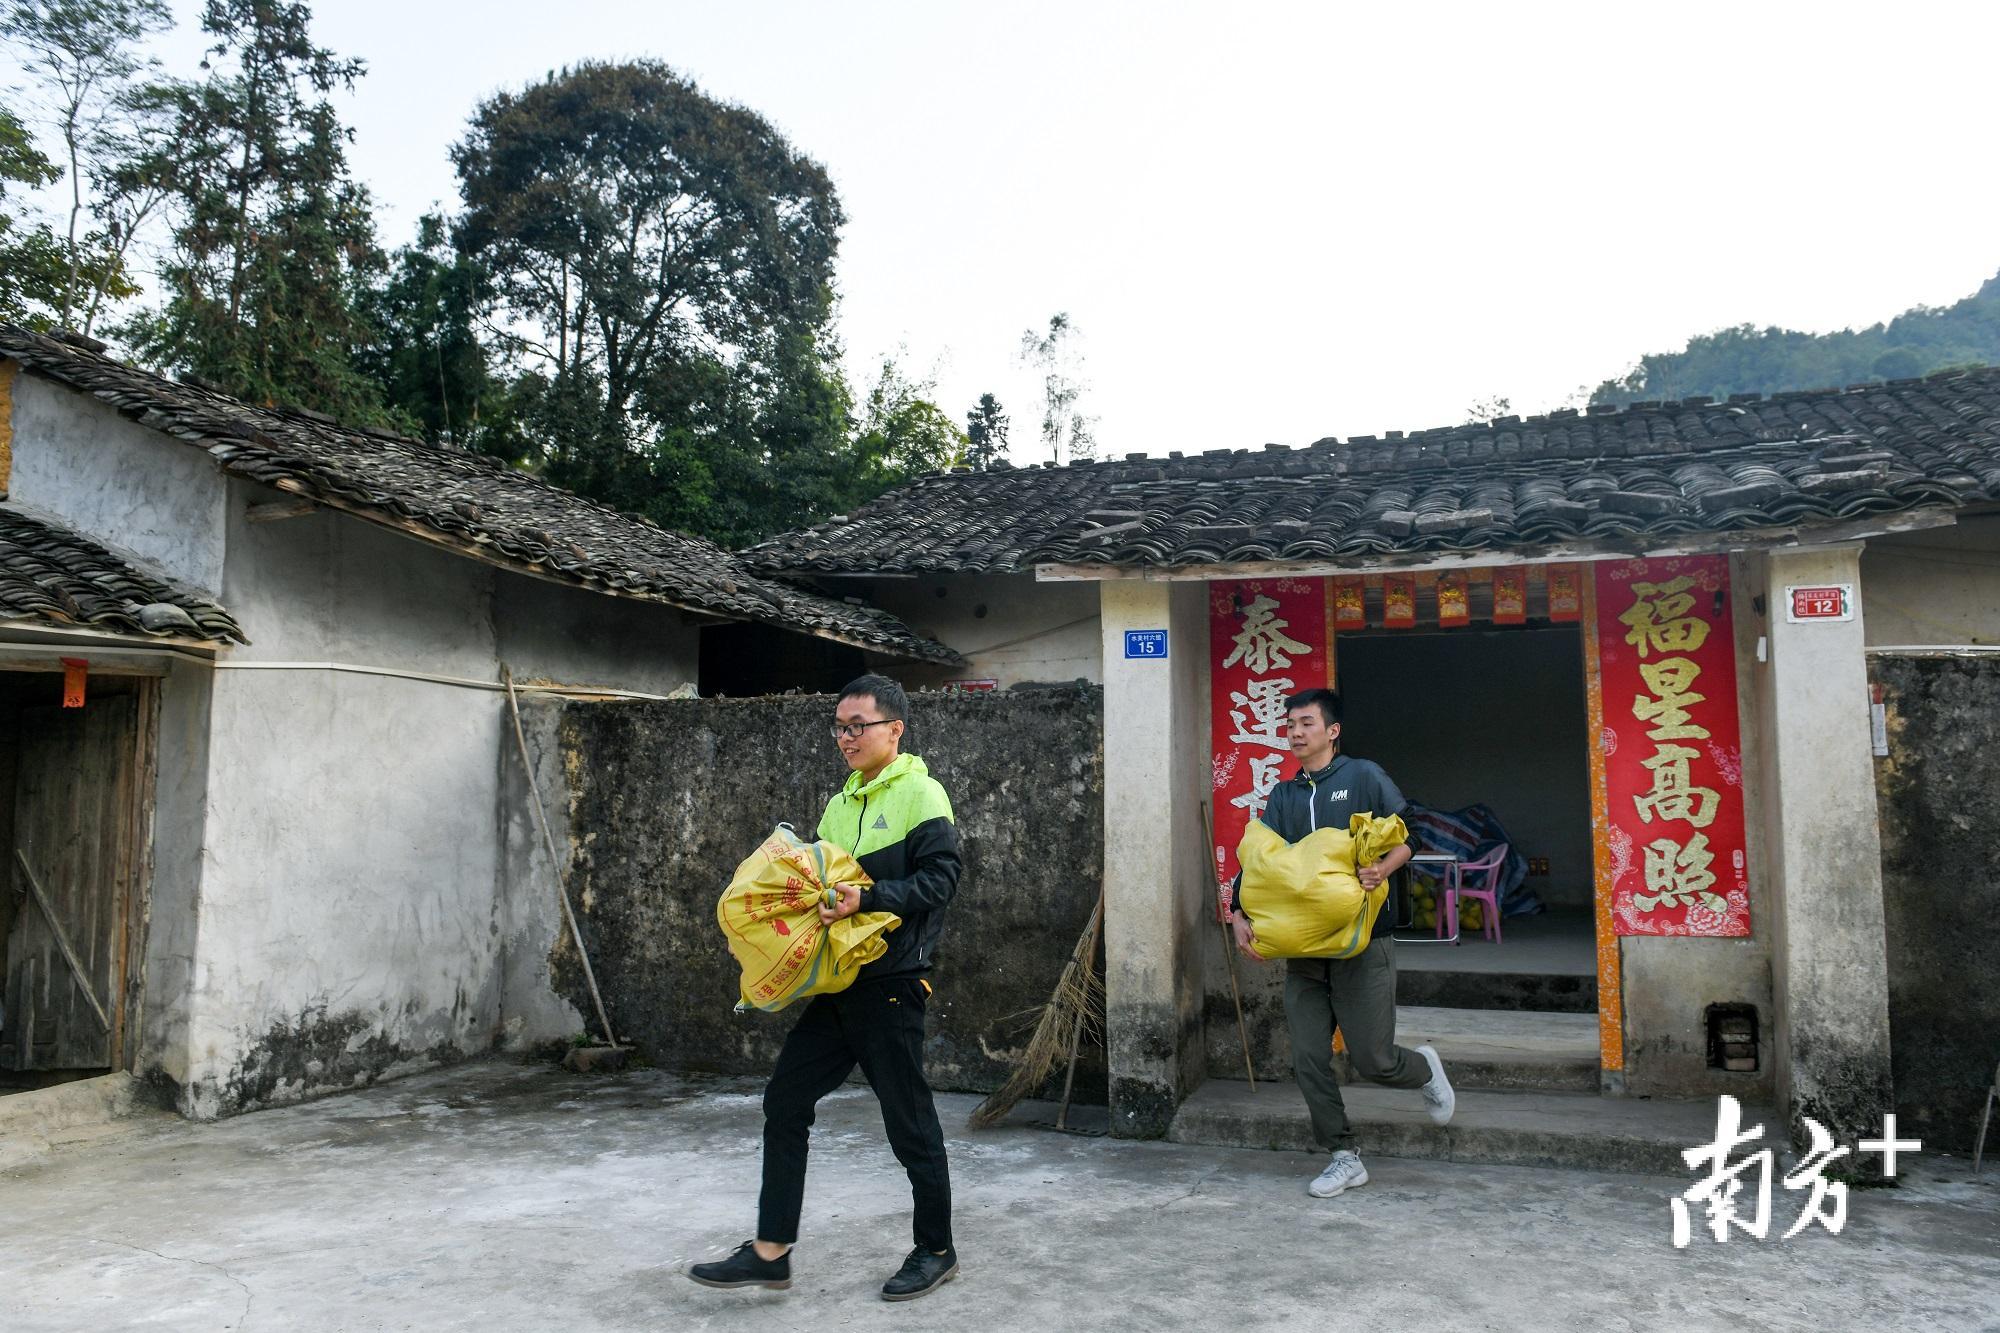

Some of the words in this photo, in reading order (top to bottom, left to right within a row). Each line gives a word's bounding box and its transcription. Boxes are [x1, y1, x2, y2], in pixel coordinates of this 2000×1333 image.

[1814, 600, 1833, 613] 12
[1138, 642, 1154, 654] 15
[1618, 575, 1729, 914] 福星高照
[1330, 789, 1349, 801] KM
